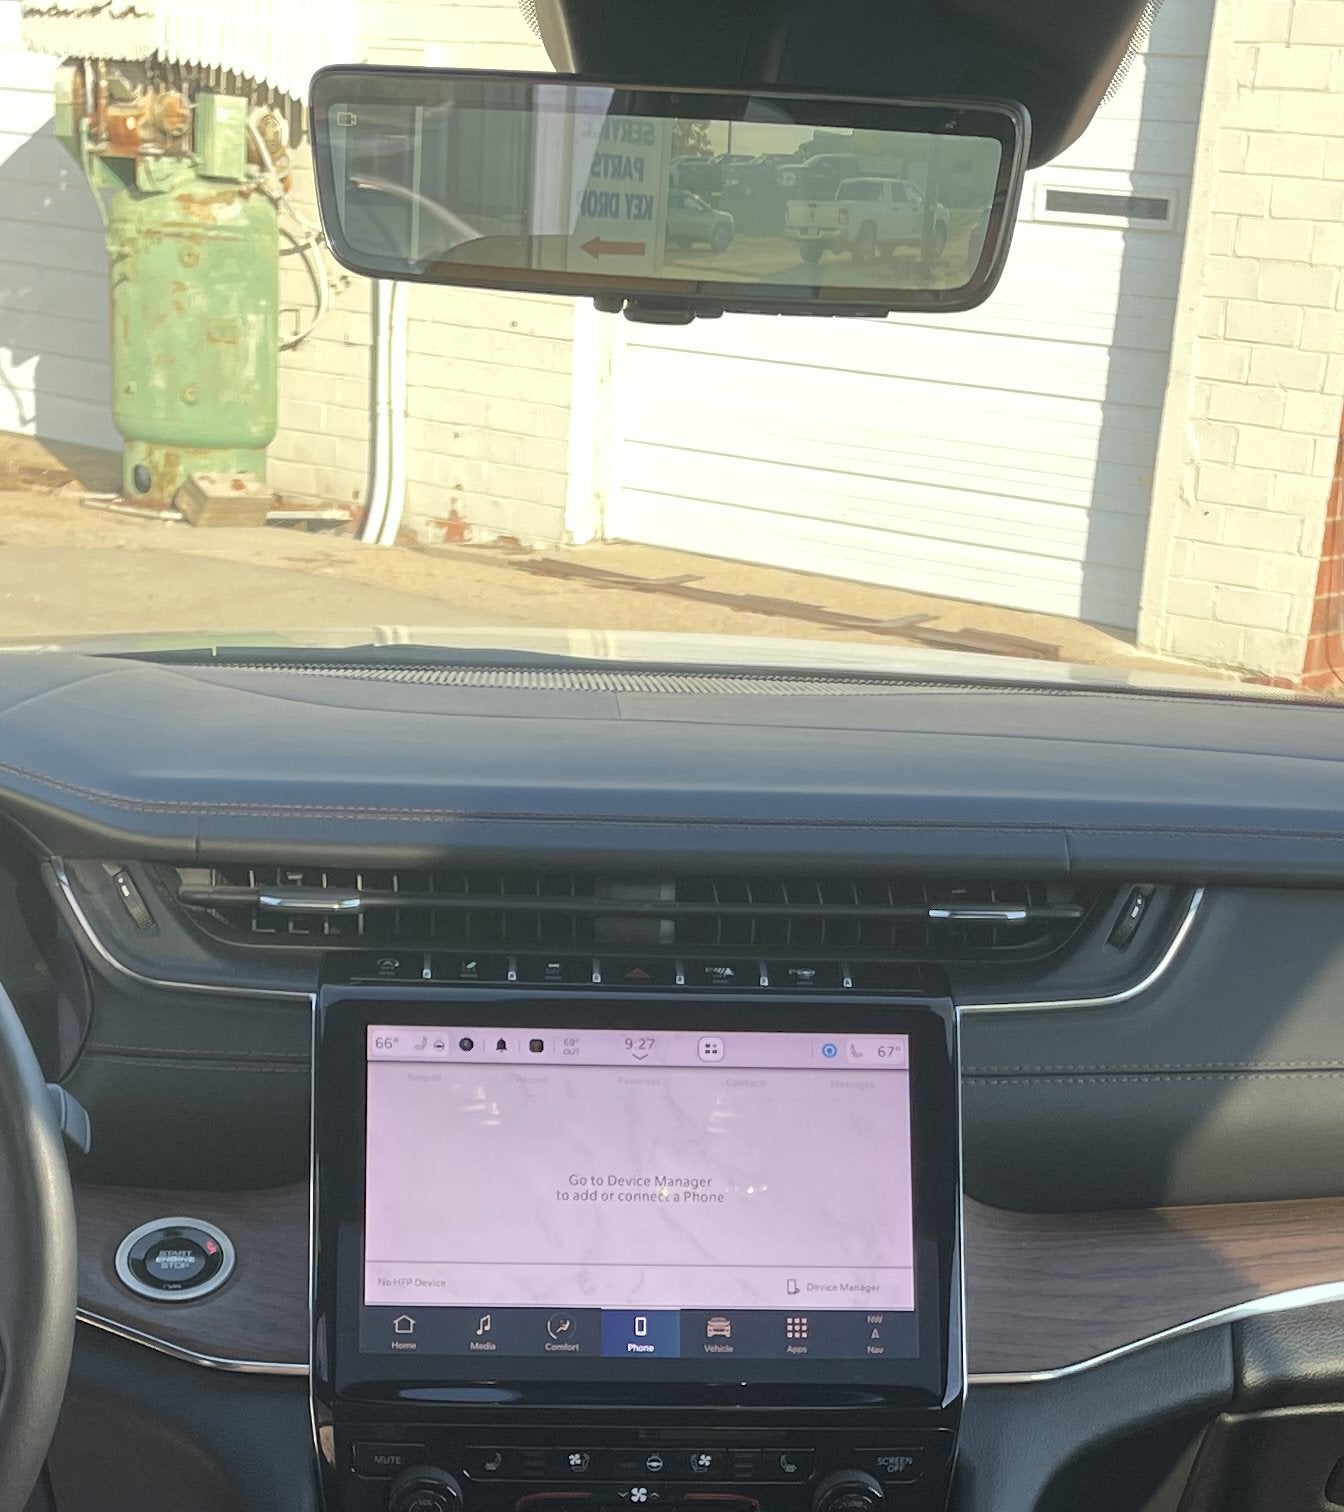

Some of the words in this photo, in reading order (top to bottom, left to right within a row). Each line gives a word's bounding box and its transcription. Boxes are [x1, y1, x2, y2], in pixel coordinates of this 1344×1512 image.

[624, 1038, 655, 1050] 9:27
[516, 1075, 548, 1084] Recent
[568, 1174, 587, 1186] Go
[590, 1175, 603, 1186] to
[607, 1174, 651, 1187] Device
[655, 1176, 712, 1190] Manager
[556, 1190, 569, 1201] to
[573, 1189, 598, 1201] add
[601, 1191, 613, 1202] or
[673, 1193, 680, 1203] a
[684, 1191, 725, 1203] Phone
[414, 1278, 446, 1288] Device
[806, 1282, 836, 1292] Device
[839, 1282, 881, 1294] Manager
[391, 1341, 417, 1350] Home
[470, 1341, 497, 1351] Media
[544, 1342, 580, 1352] Comfort
[627, 1343, 654, 1352] Phone
[704, 1344, 734, 1353] Vehicle
[786, 1345, 808, 1354] Apps
[867, 1345, 884, 1354] Nav
[374, 1455, 401, 1464] MUTE
[877, 1456, 913, 1465] SCREEN
[885, 1465, 905, 1473] OFF
